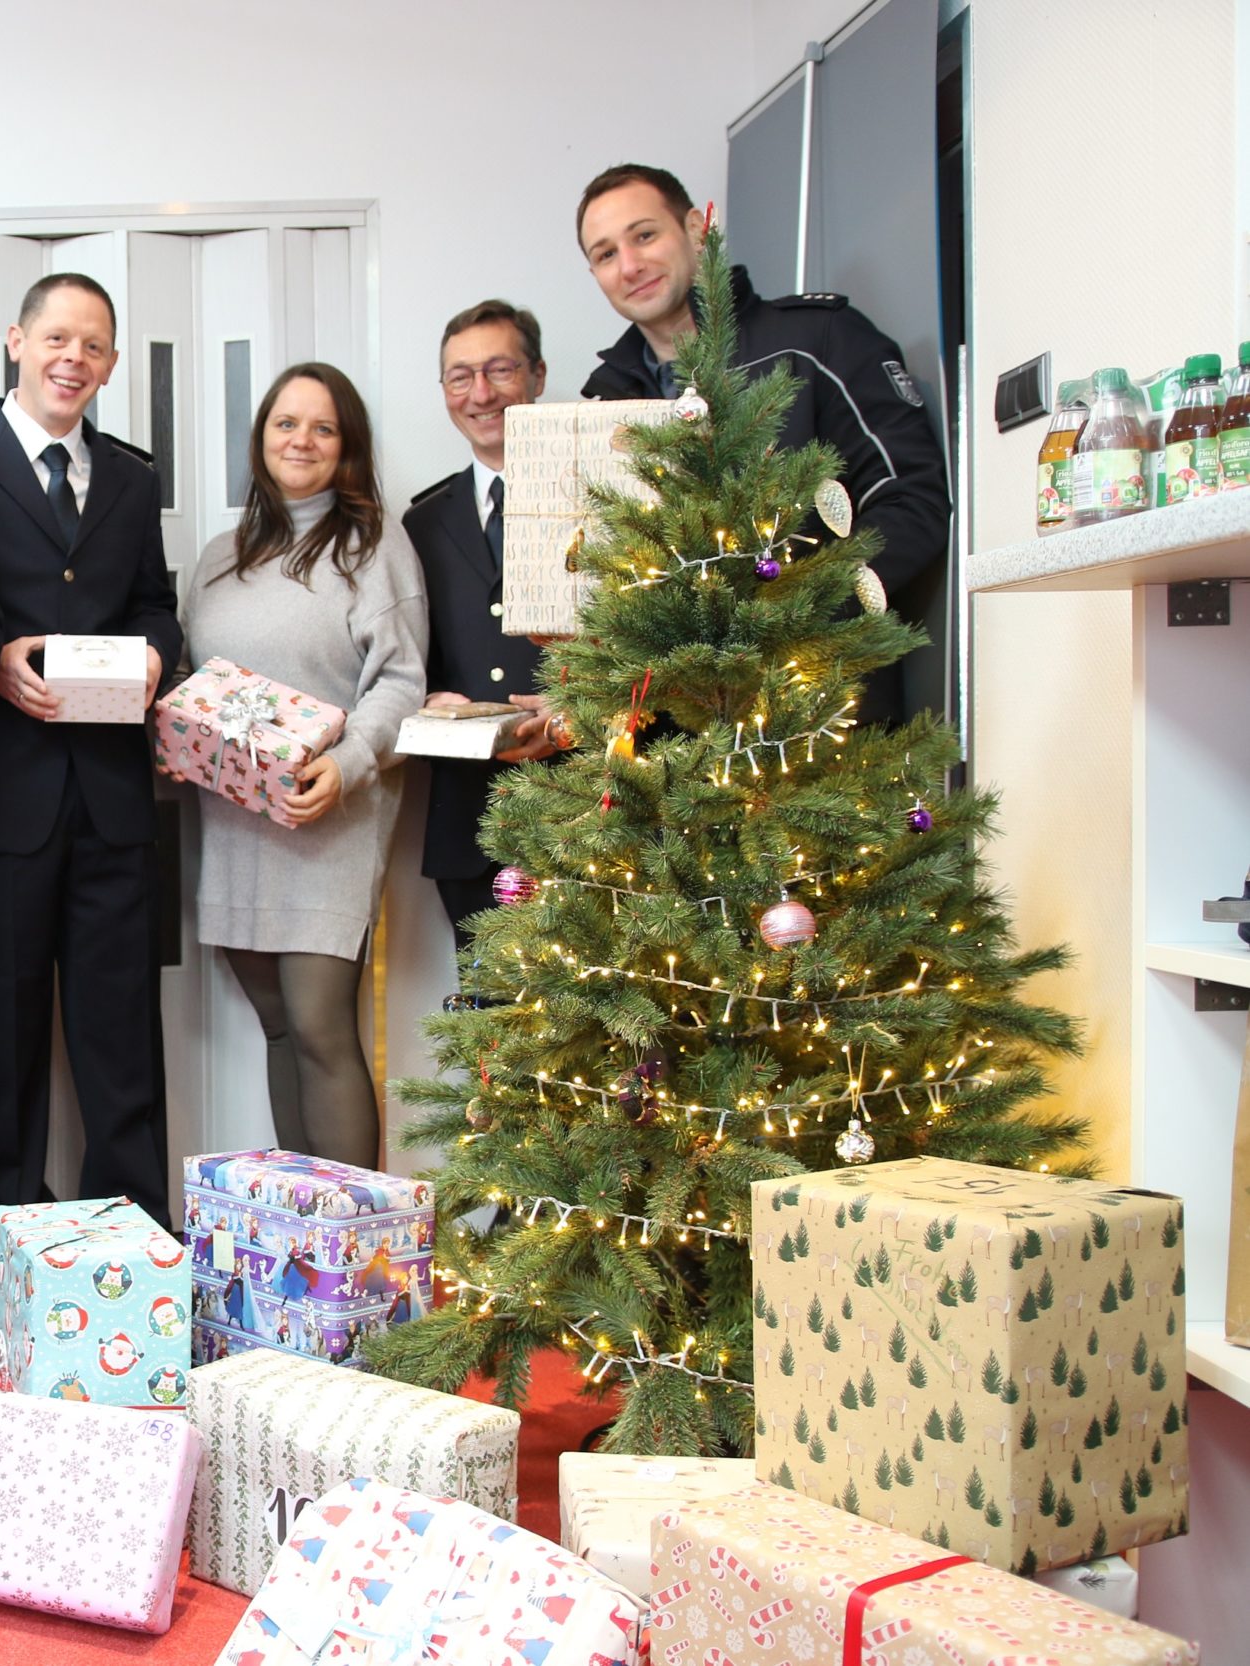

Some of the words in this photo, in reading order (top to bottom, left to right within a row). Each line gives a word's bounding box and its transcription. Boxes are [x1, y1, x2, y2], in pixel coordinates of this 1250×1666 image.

[521, 416, 559, 437] MERRY
[507, 439, 546, 459] MERRY
[521, 460, 560, 480] MERRY
[268, 1487, 315, 1546] 1
